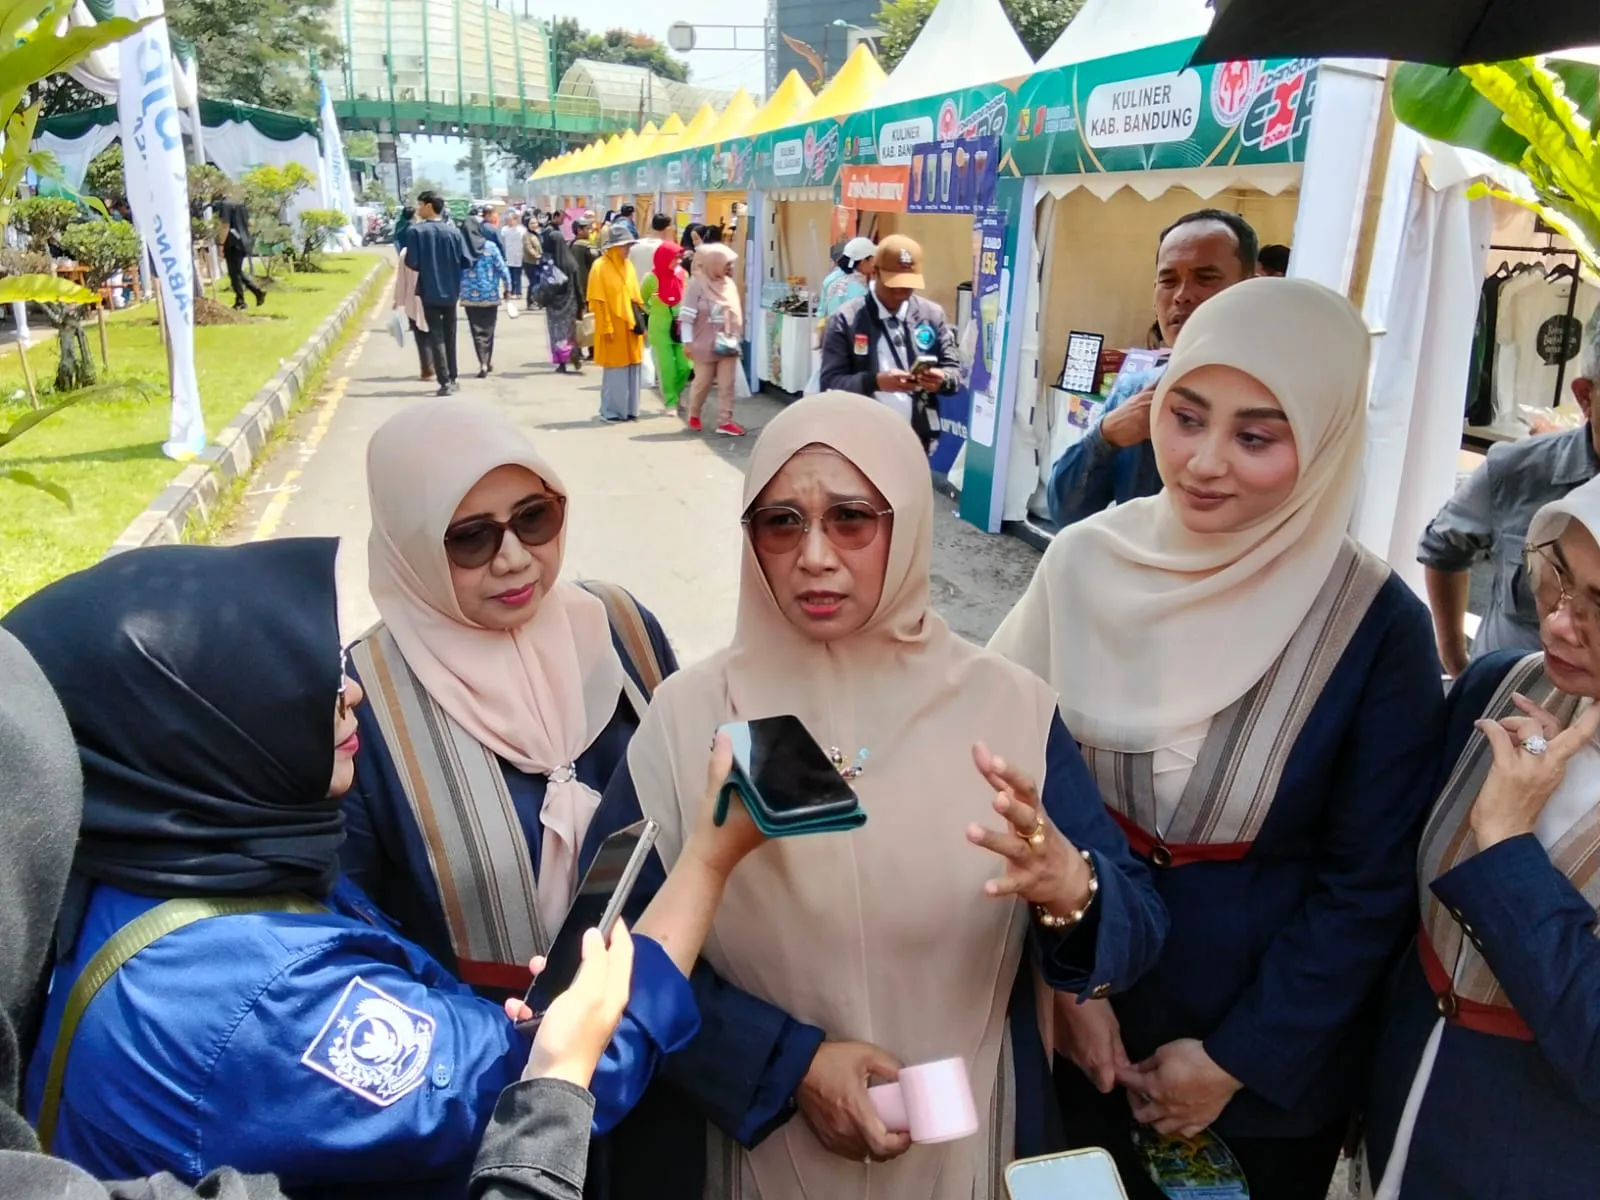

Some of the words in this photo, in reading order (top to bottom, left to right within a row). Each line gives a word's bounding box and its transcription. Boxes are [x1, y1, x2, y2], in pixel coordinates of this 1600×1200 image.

[1111, 84, 1172, 111] KULINER
[891, 125, 921, 142] KULINER
[1090, 116, 1120, 137] KAB.
[1123, 107, 1193, 134] BANDUNG
